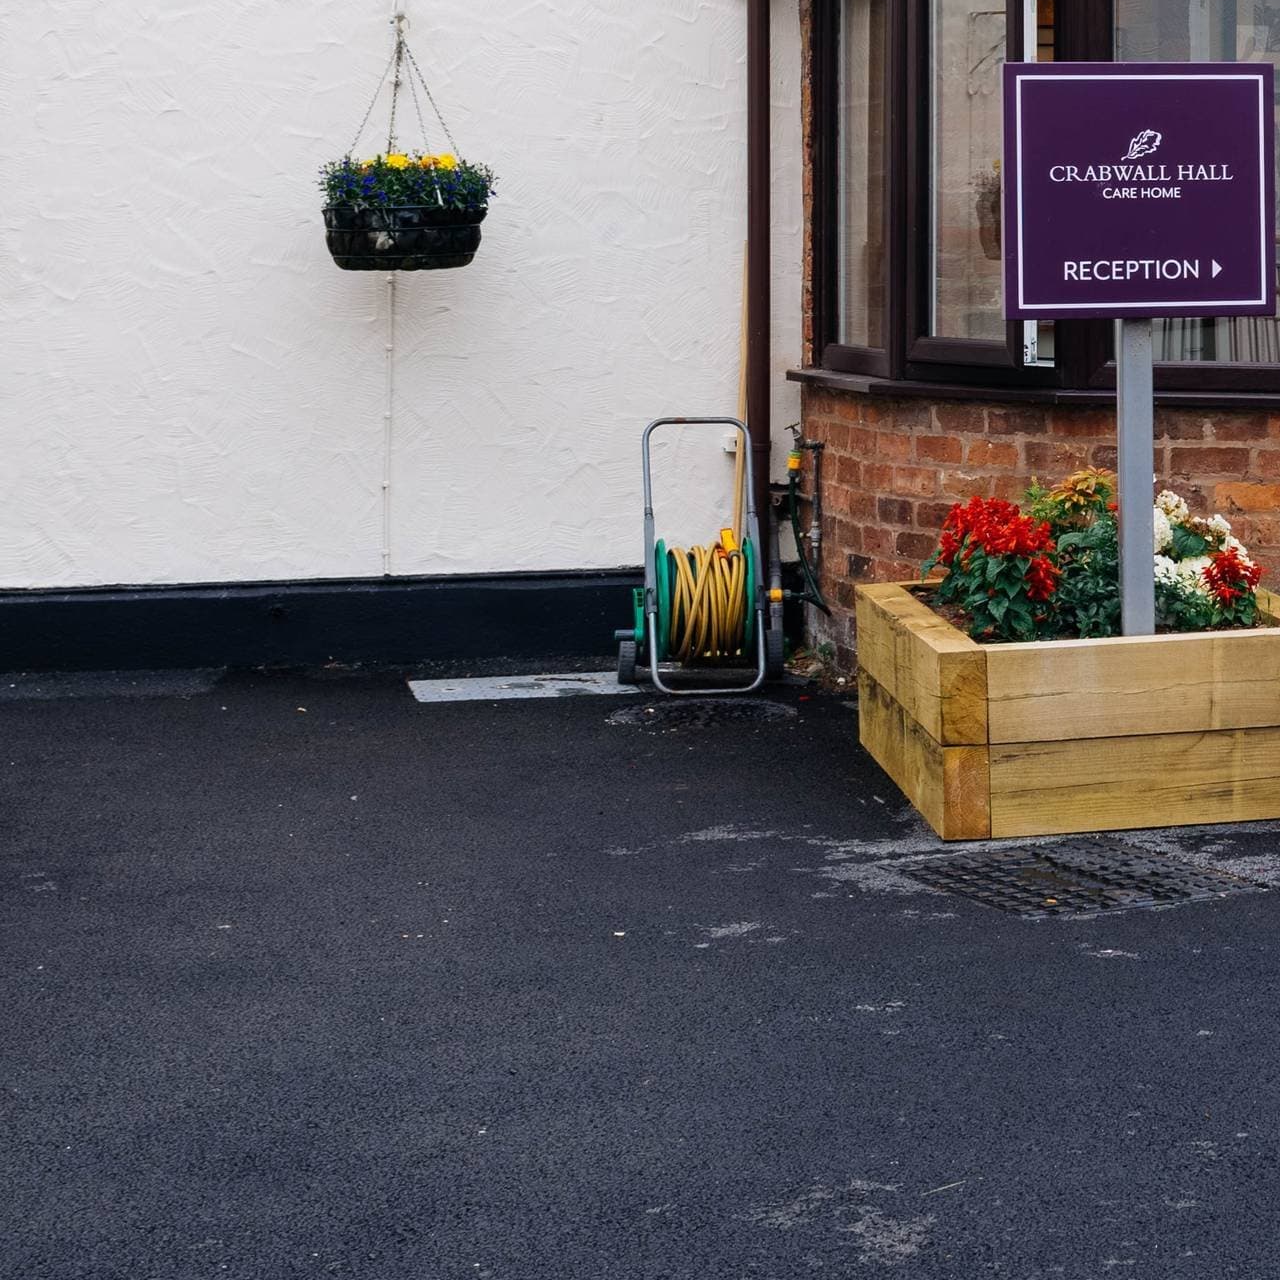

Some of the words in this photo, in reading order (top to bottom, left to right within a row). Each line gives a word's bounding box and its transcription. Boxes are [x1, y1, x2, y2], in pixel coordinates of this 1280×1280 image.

[1049, 165, 1171, 182] CRABWALL
[1177, 164, 1234, 181] HALL
[1102, 187, 1137, 199] CARE
[1141, 187, 1181, 198] HOME
[1063, 259, 1199, 281] RECEPTION
